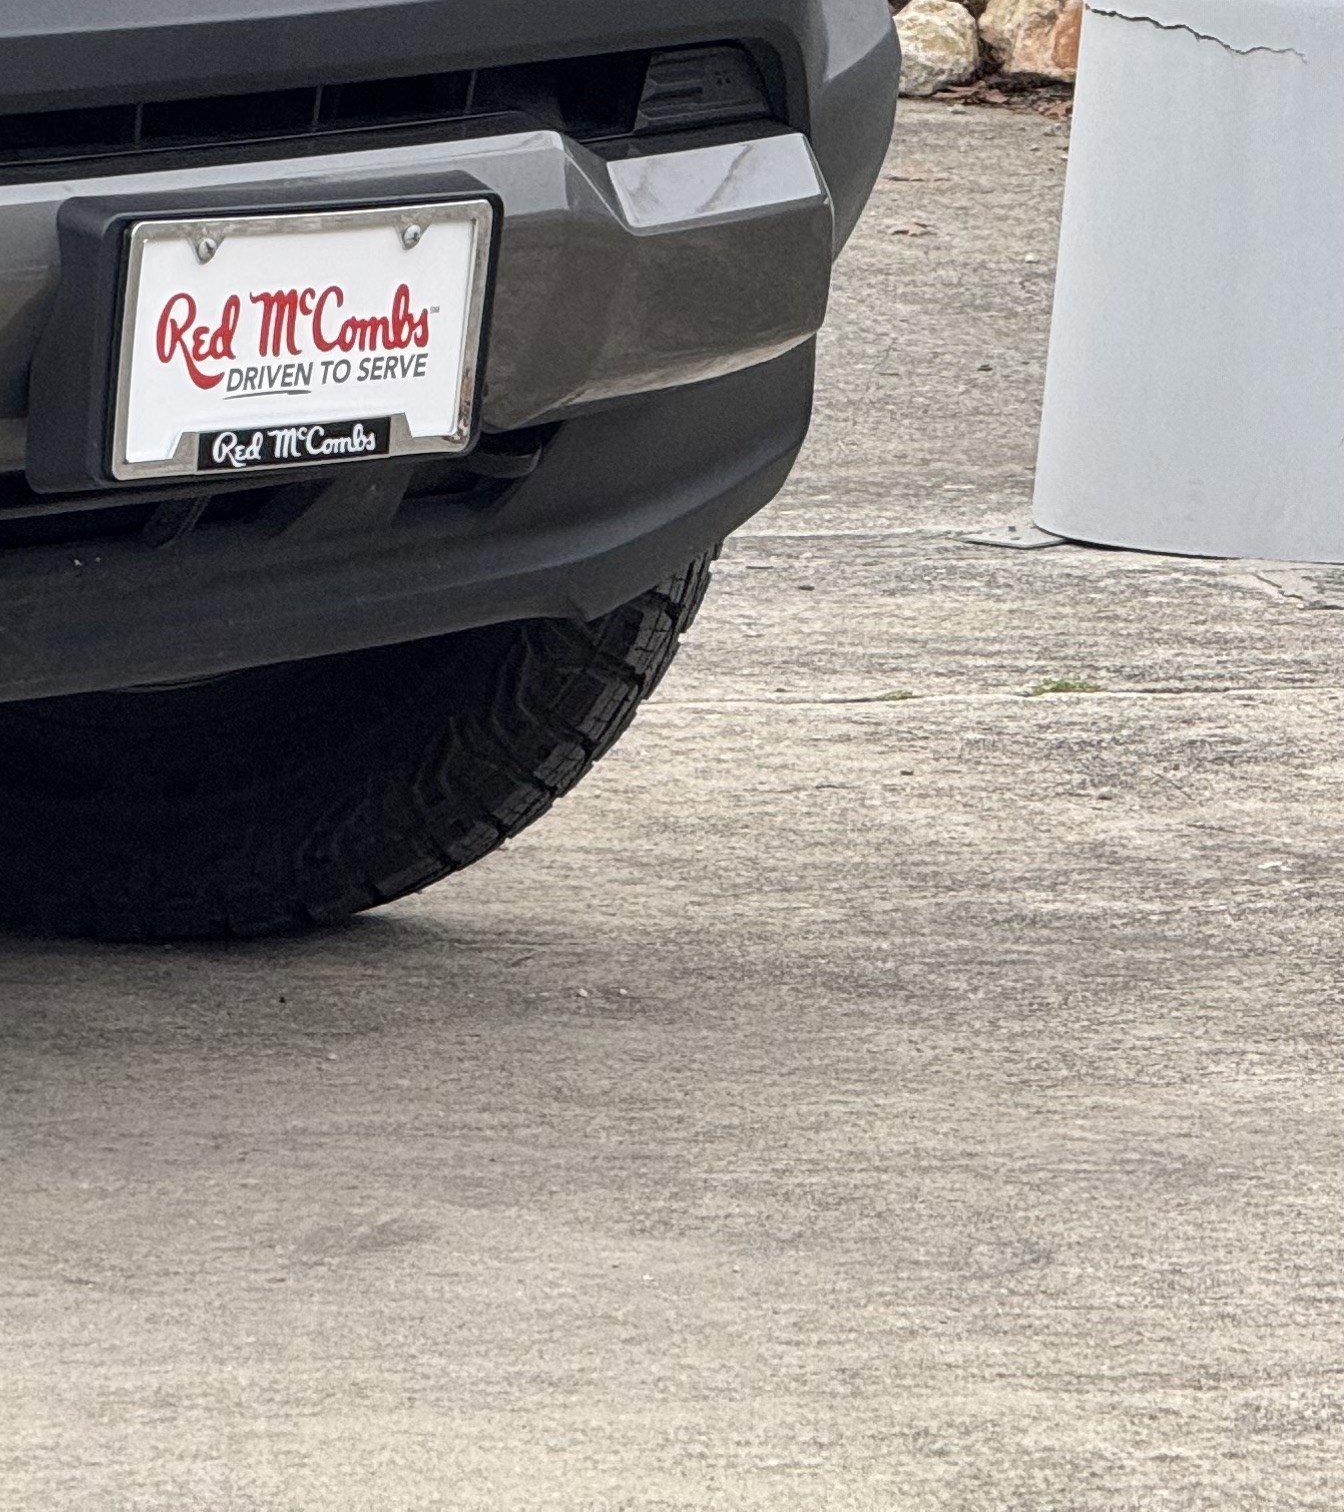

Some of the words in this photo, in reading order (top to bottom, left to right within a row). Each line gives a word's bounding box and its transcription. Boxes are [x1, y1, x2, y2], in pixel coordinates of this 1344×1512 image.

[156, 292, 241, 389] Red
[250, 284, 430, 357] McCombs
[226, 361, 313, 393] DRIVEN
[321, 358, 352, 385] TO
[357, 353, 429, 382] SERVE
[213, 431, 261, 467] Red
[268, 423, 376, 459] McCombs
